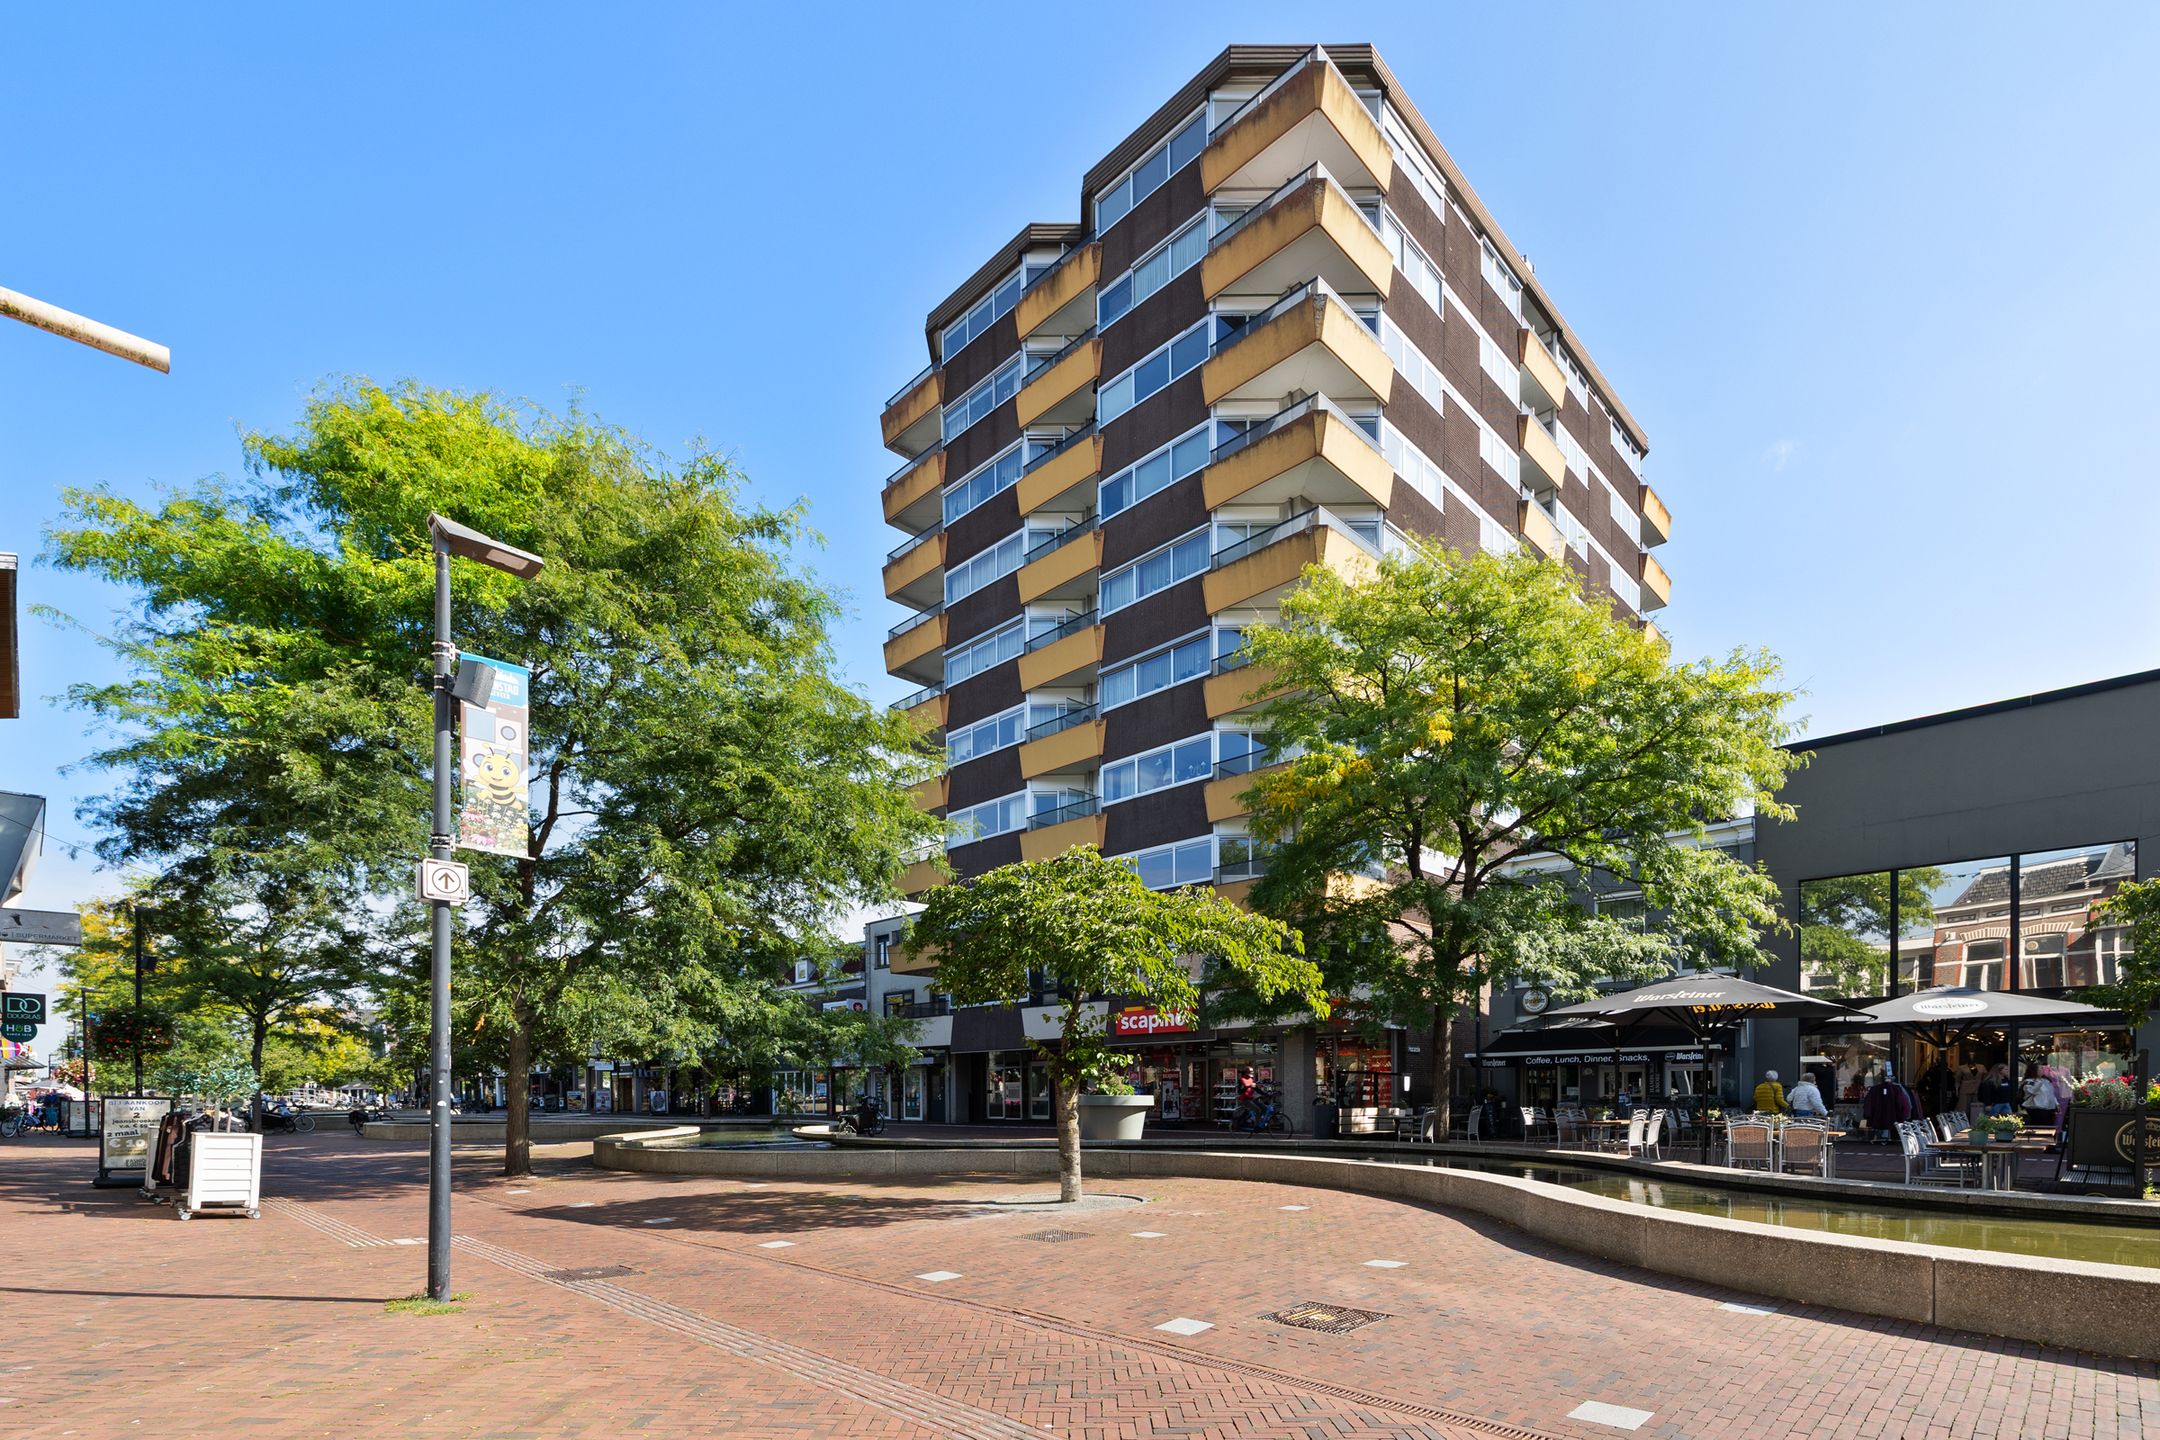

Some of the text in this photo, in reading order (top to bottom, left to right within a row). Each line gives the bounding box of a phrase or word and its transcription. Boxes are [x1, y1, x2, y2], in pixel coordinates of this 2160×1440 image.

[16, 932, 78, 941] SUPERMARKET
[1633, 990, 1727, 1003] Warsteiner
[1525, 1053, 1650, 1065] Coffee, Lunch, Dinner, Snacks,
[109, 1138, 121, 1148] €
